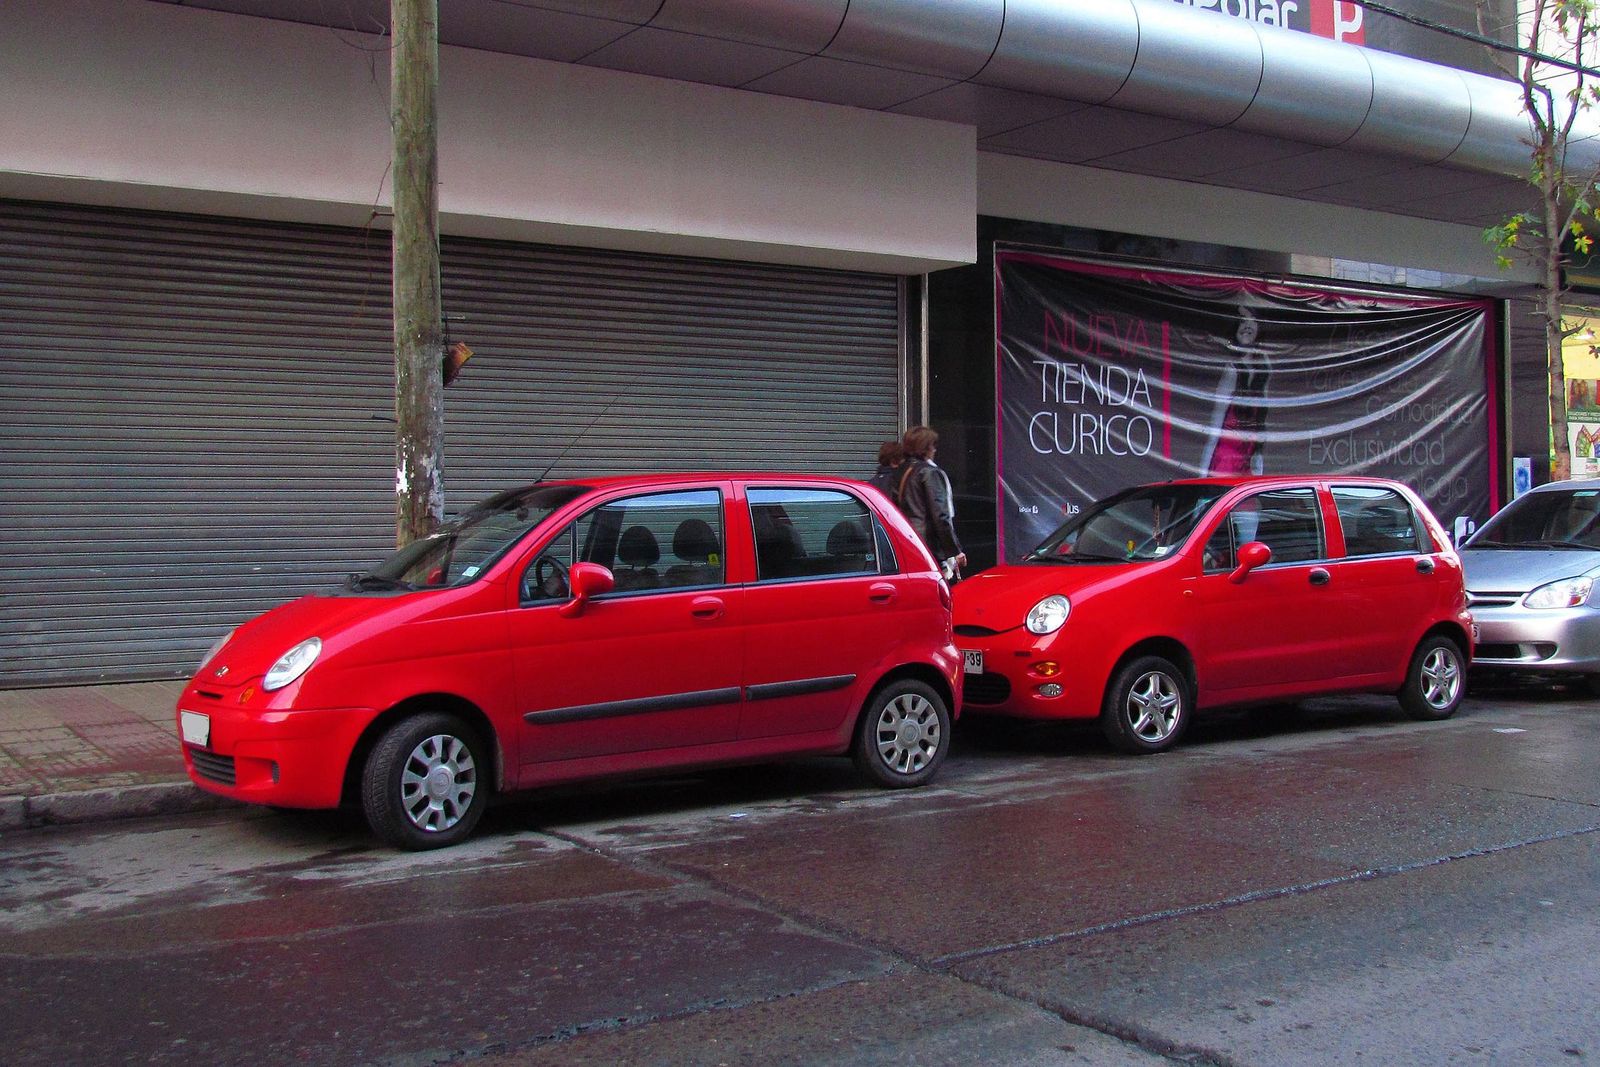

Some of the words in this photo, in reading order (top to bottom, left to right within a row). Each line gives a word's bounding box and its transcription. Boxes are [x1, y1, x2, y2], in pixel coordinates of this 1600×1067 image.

[1043, 309, 1150, 357] NUEVA
[1033, 360, 1152, 407] TIENDA
[1029, 411, 1152, 456] CURICO
[1308, 430, 1445, 466] Exclusividad
